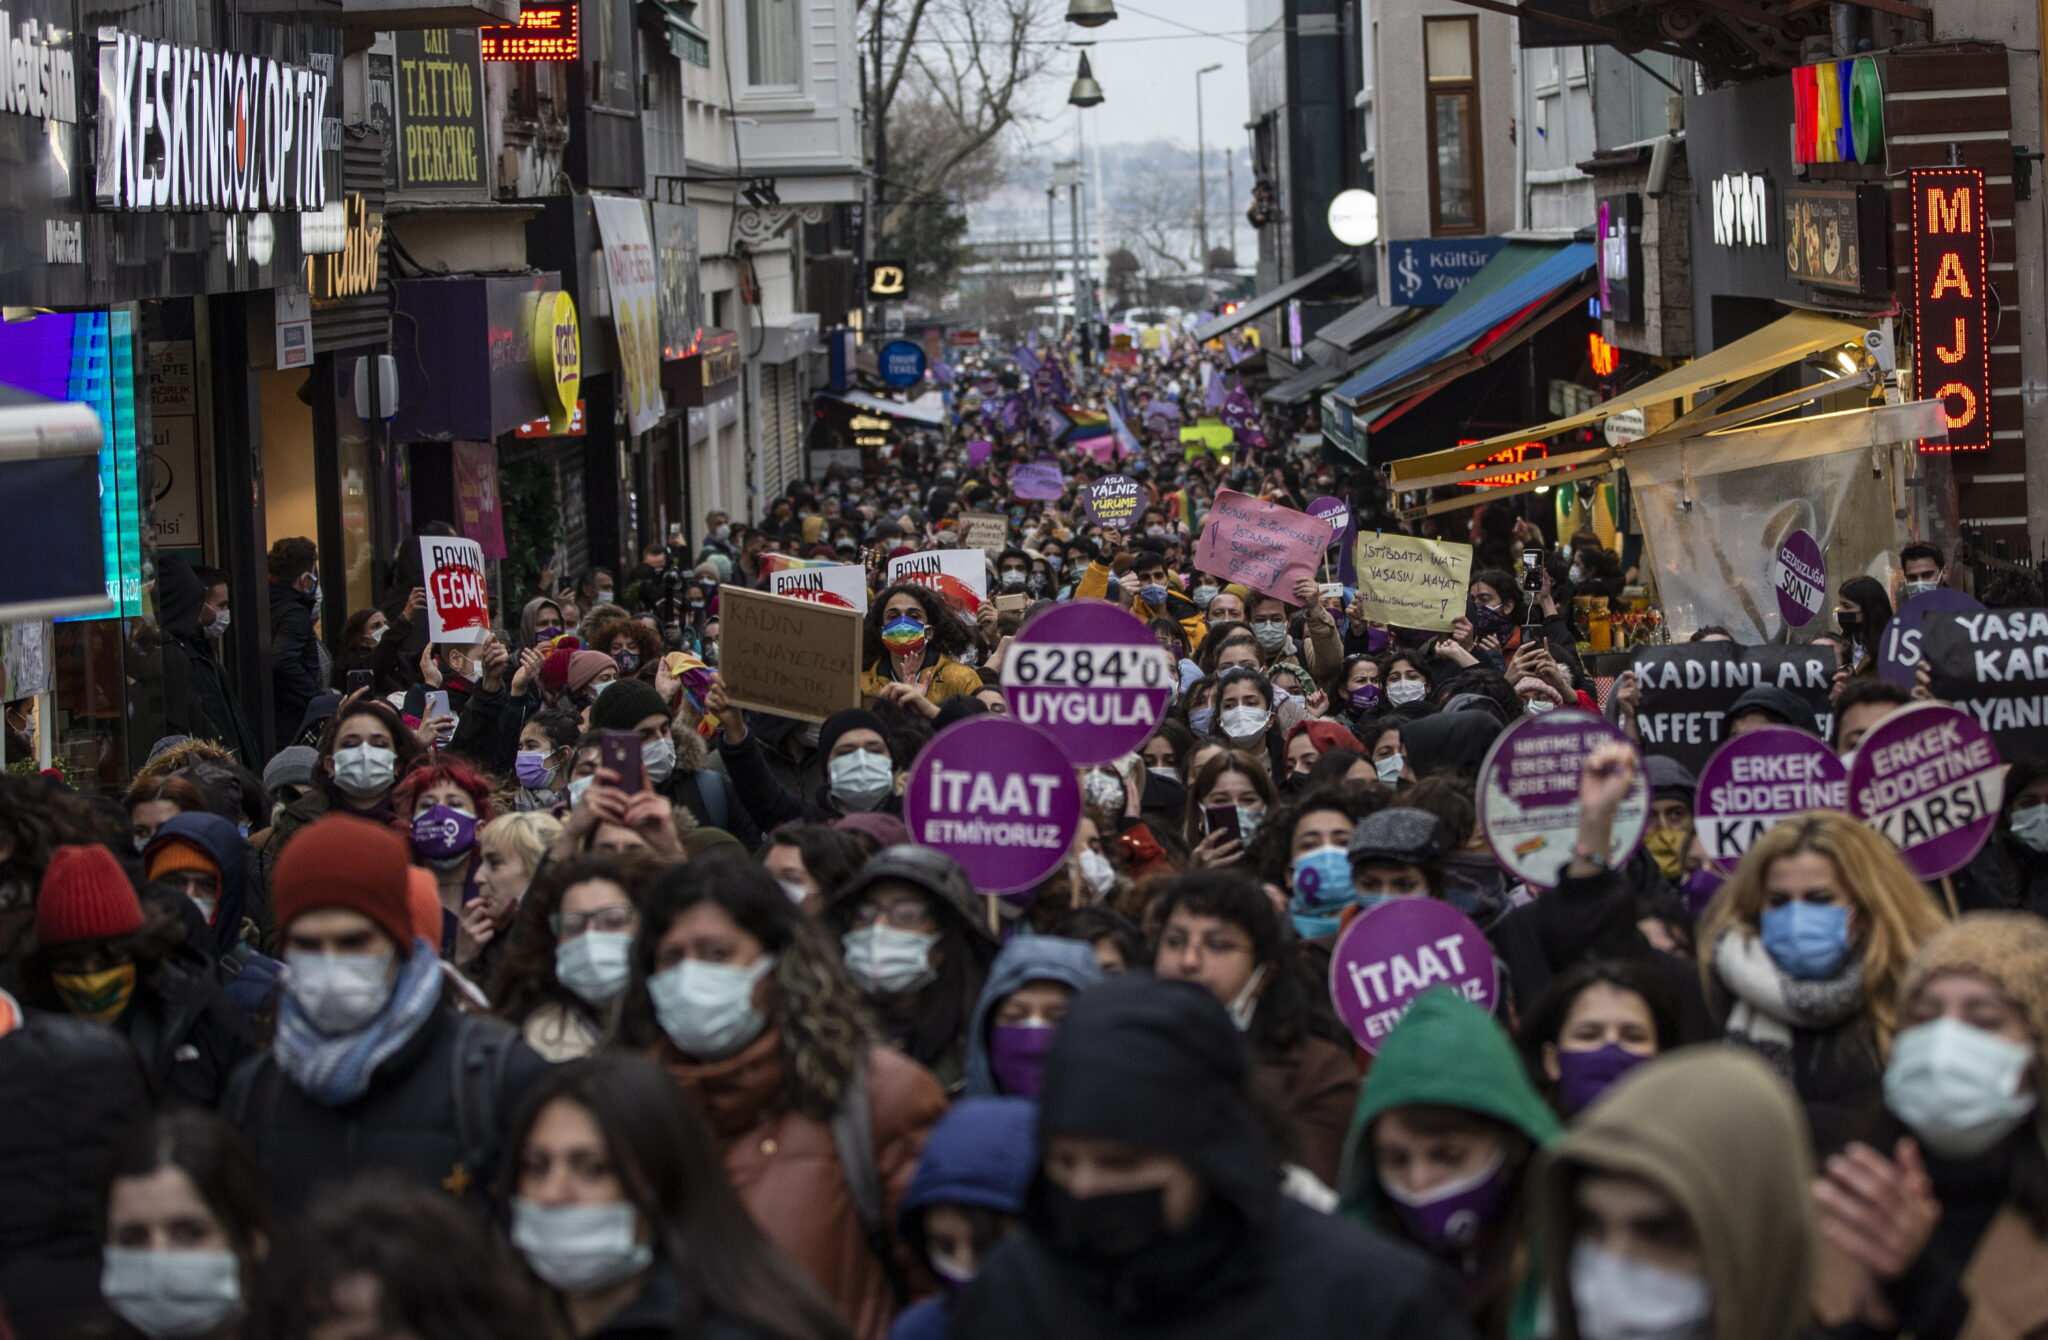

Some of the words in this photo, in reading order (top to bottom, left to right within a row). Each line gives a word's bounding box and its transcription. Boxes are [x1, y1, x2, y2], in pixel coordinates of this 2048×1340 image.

[401, 59, 473, 118] TATTOO
[406, 124, 477, 182] PIERCING
[1430, 252, 1488, 268] Kültür
[1927, 187, 1976, 429] MAJO
[162, 363, 188, 376] PTE
[888, 365, 919, 375] TEKEL
[151, 384, 191, 395] AZIRLIK
[1091, 483, 1138, 498] YALNIZ
[1104, 476, 1124, 485] ASLA
[1092, 495, 1138, 511] YÜRÜME
[1218, 502, 1251, 523] BOYUN
[432, 545, 481, 572] BOYUN
[895, 554, 943, 580] BOYUN
[1781, 546, 1825, 587] CEZASIZLIĞA
[436, 571, 488, 609] EĞME
[777, 571, 824, 595] BOYUN
[1782, 568, 1812, 608] SON!
[730, 601, 803, 637] KADIN
[1635, 659, 1828, 690] KADINLAR
[1017, 692, 1155, 726] UYGULA
[1871, 717, 1965, 777] ERKEK
[1730, 751, 1826, 784] ERKEK
[1858, 736, 1993, 817] ŞİDDETİNE
[928, 759, 1061, 818] İTAAT
[1710, 778, 1848, 817] ŞİDDETİNE
[924, 816, 1062, 849] ETMİYORUZ
[1346, 932, 1466, 1010] İTAAT
